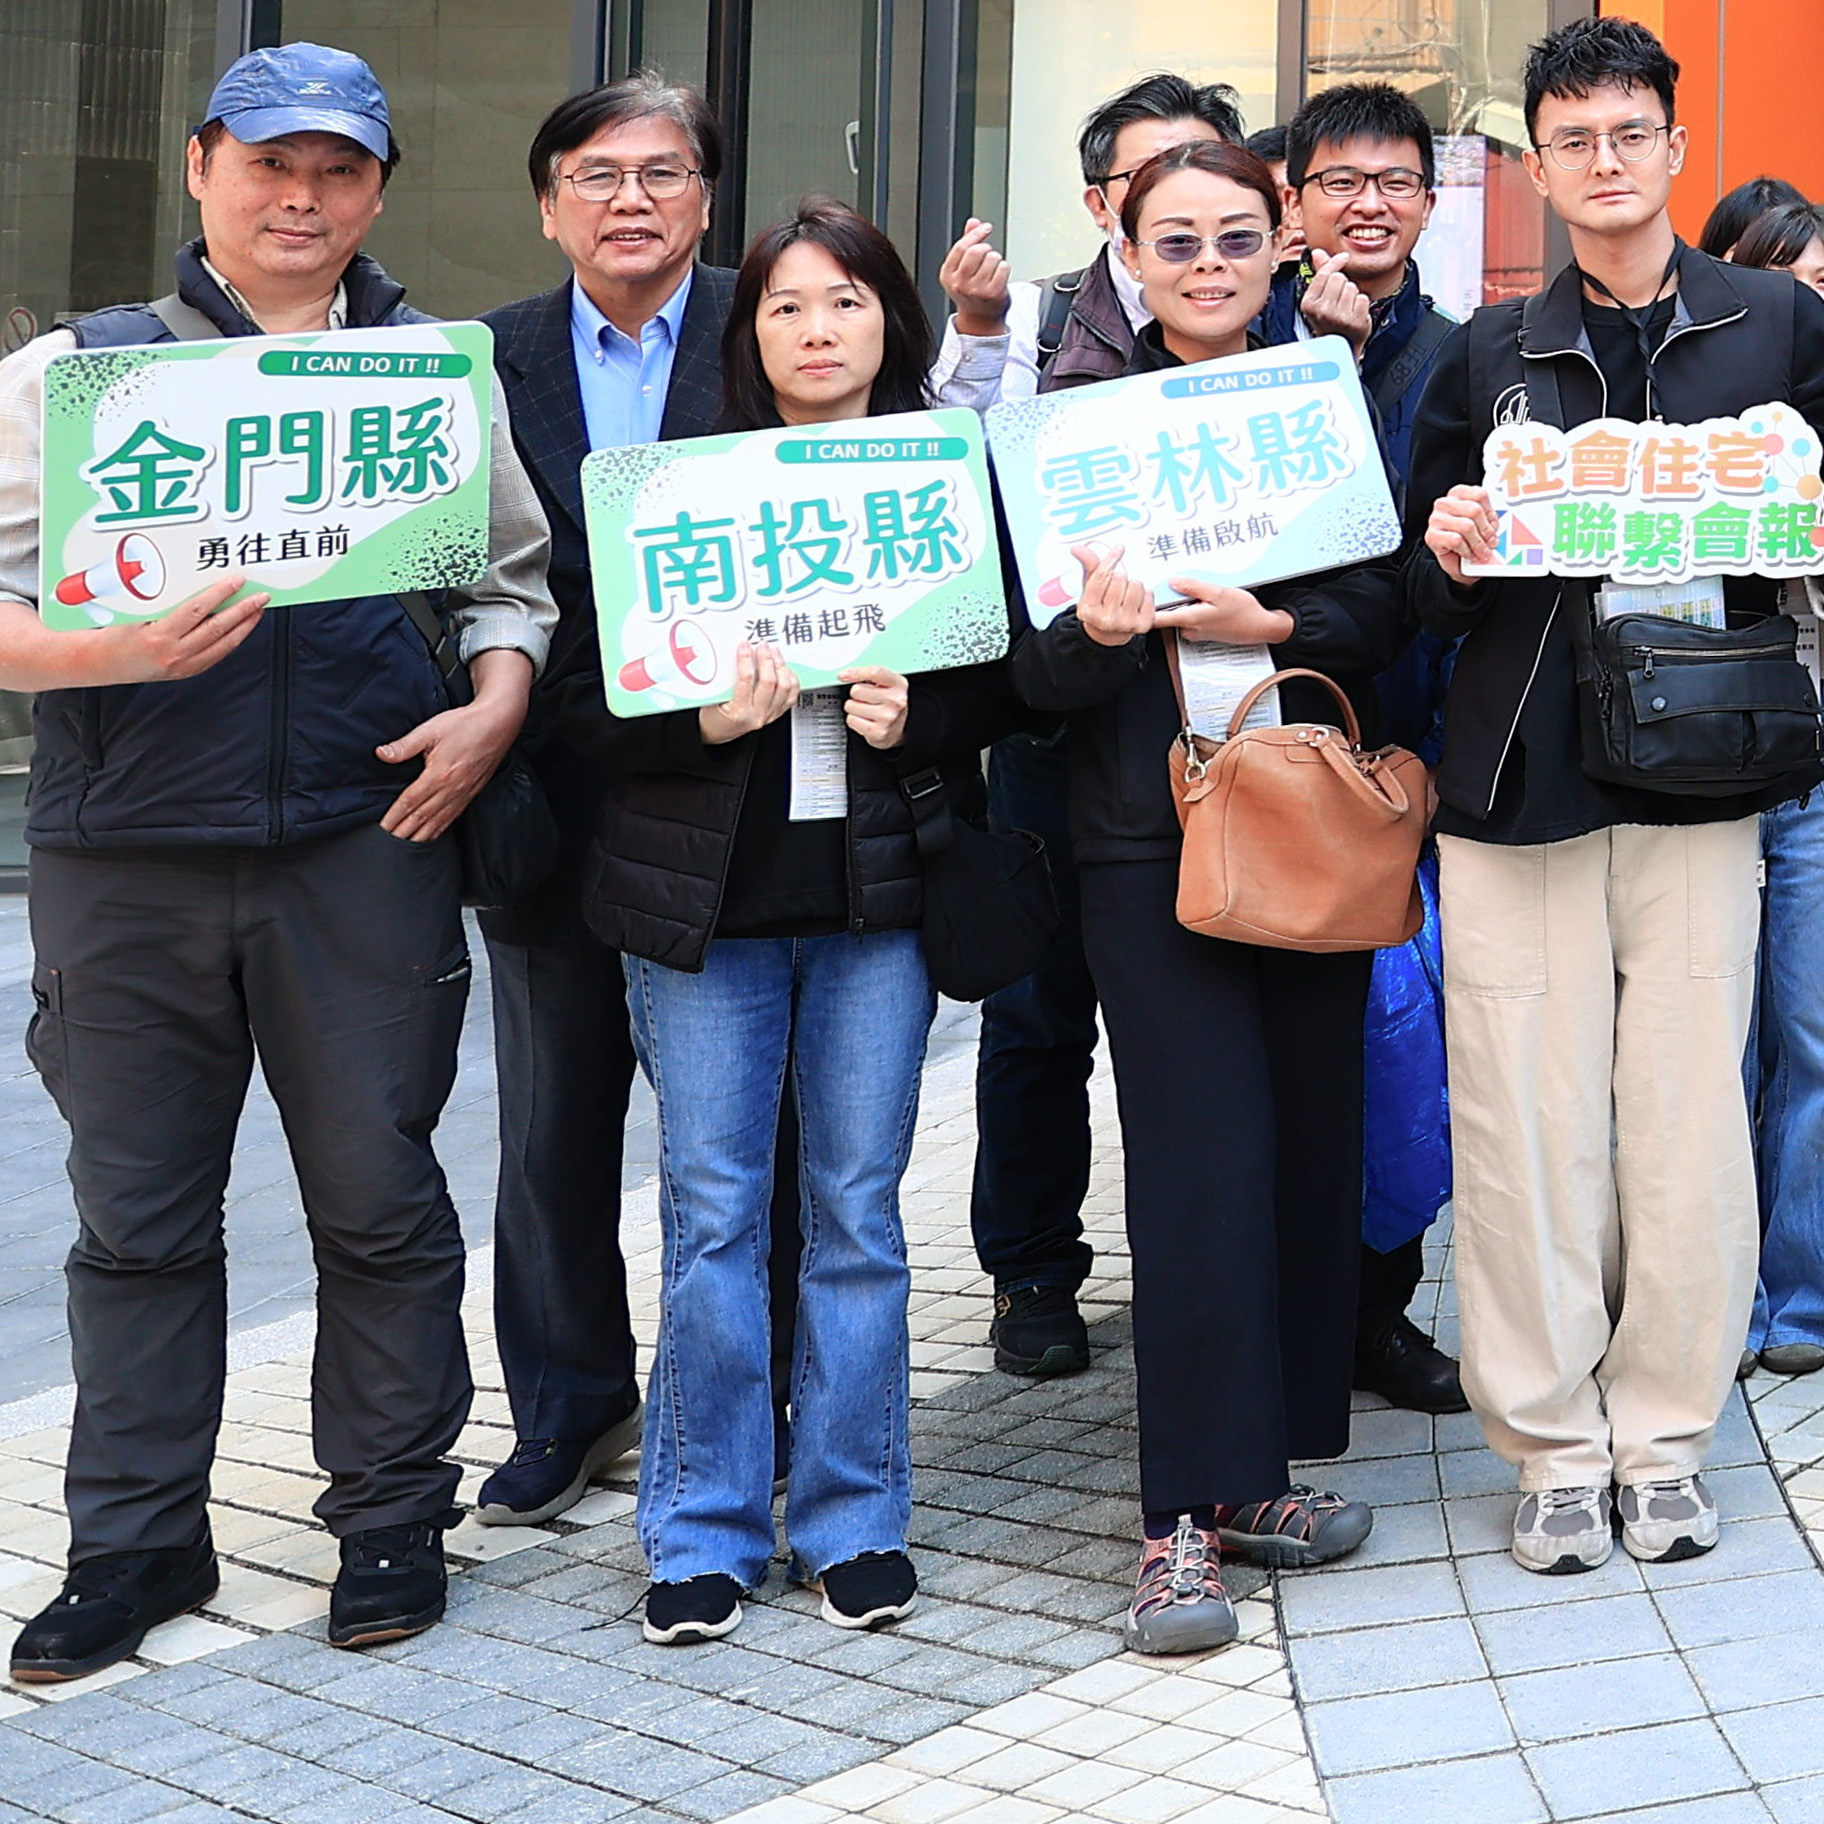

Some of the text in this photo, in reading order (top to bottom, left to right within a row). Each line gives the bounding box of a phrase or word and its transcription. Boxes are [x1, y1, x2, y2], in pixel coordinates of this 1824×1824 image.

[292, 356, 439, 373] I CAN DO IT !!
[1188, 368, 1313, 394] I CAN DO IT !!
[88, 396, 450, 524] 金門縣
[805, 442, 938, 459] I CAN DO IT !!
[1041, 399, 1355, 536] 雲林縣
[1498, 431, 1766, 498] 社會住宅
[197, 526, 350, 570] 勇往直前
[633, 479, 963, 614] 南投縣
[1552, 502, 1818, 568] 聯繫會報
[744, 603, 886, 647] 準備起飛
